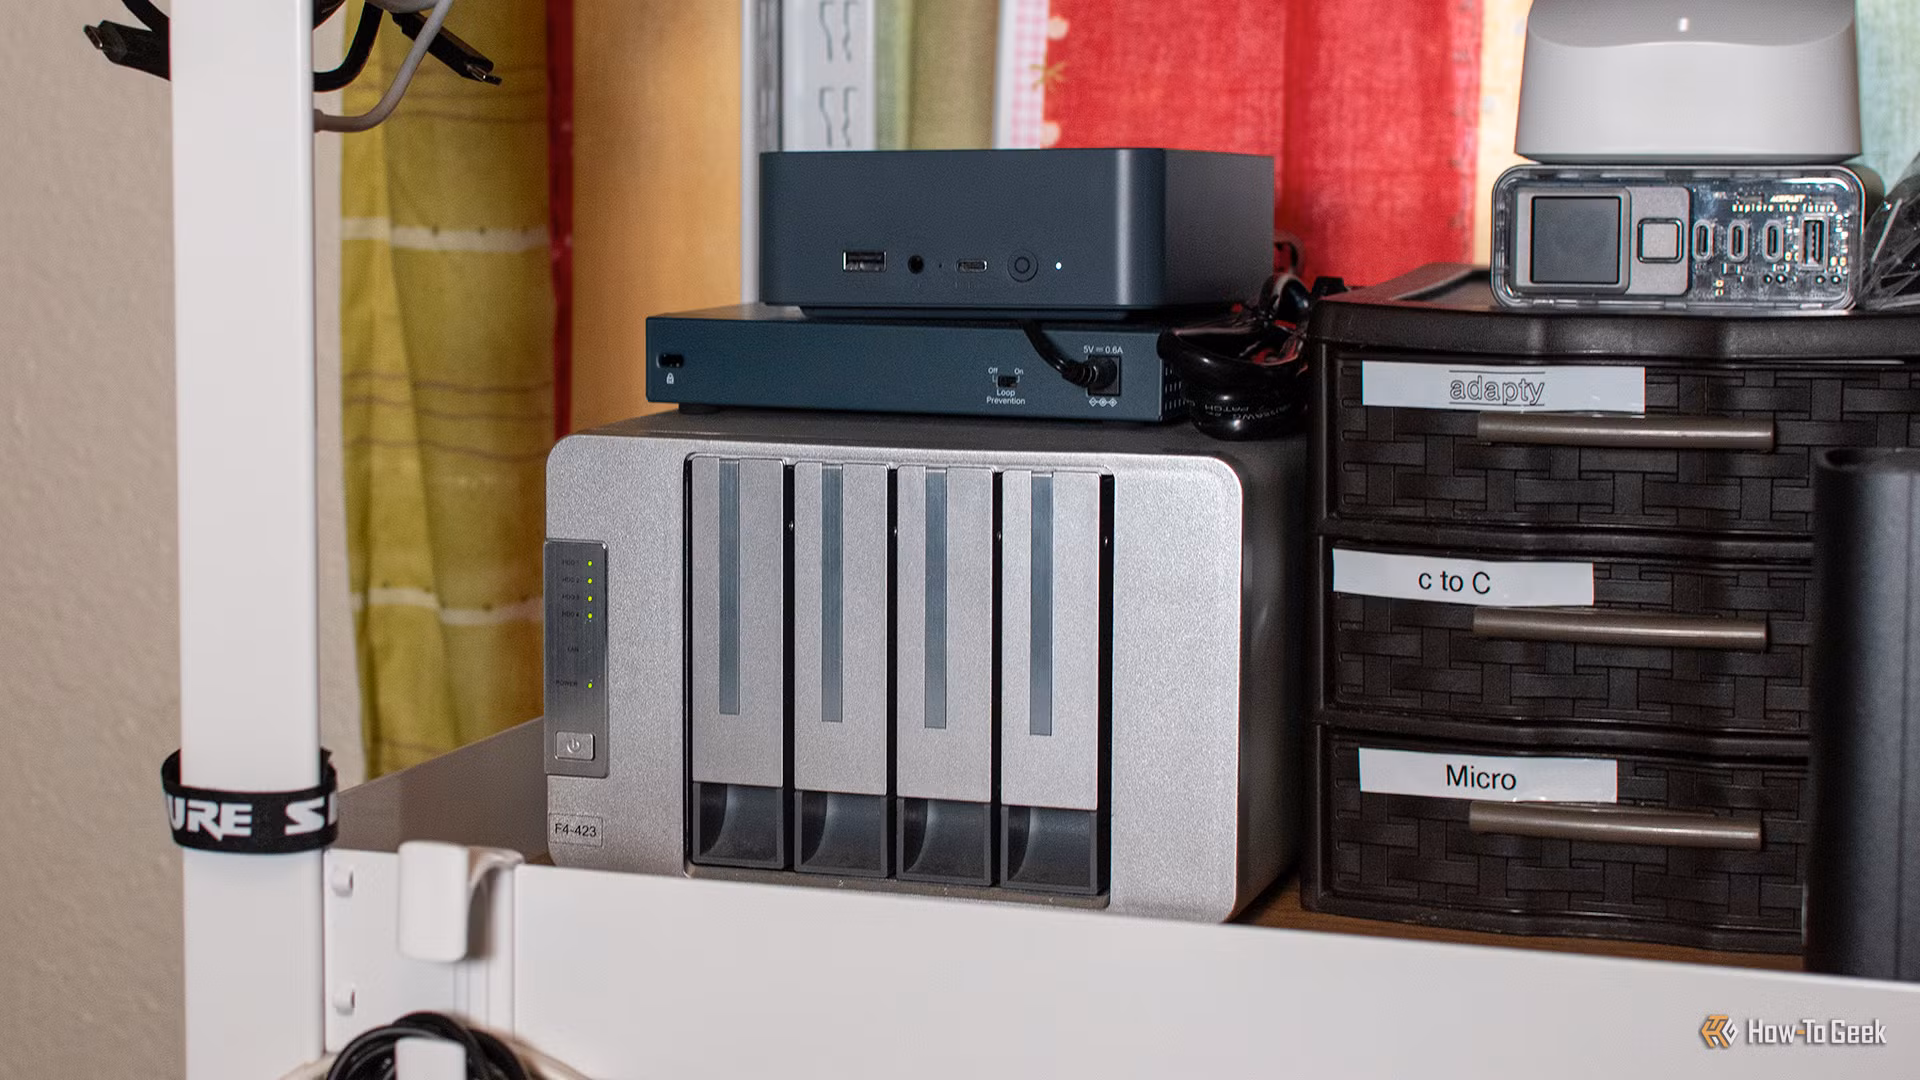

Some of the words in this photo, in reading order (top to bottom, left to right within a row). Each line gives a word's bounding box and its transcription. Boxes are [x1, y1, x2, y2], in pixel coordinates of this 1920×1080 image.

[1083, 345, 1095, 354] 5V
[1105, 345, 1124, 354] 0.6A
[988, 367, 999, 375] Off
[1014, 367, 1024, 375] On
[996, 389, 1016, 398] Loop
[1449, 374, 1545, 406] adapty
[986, 396, 1026, 406] Prevention
[1417, 571, 1432, 590] c
[1439, 570, 1464, 592] to
[1472, 571, 1491, 595] C
[555, 679, 578, 687] POWER
[1445, 764, 1517, 791] Micro
[555, 823, 597, 838] F4-423
